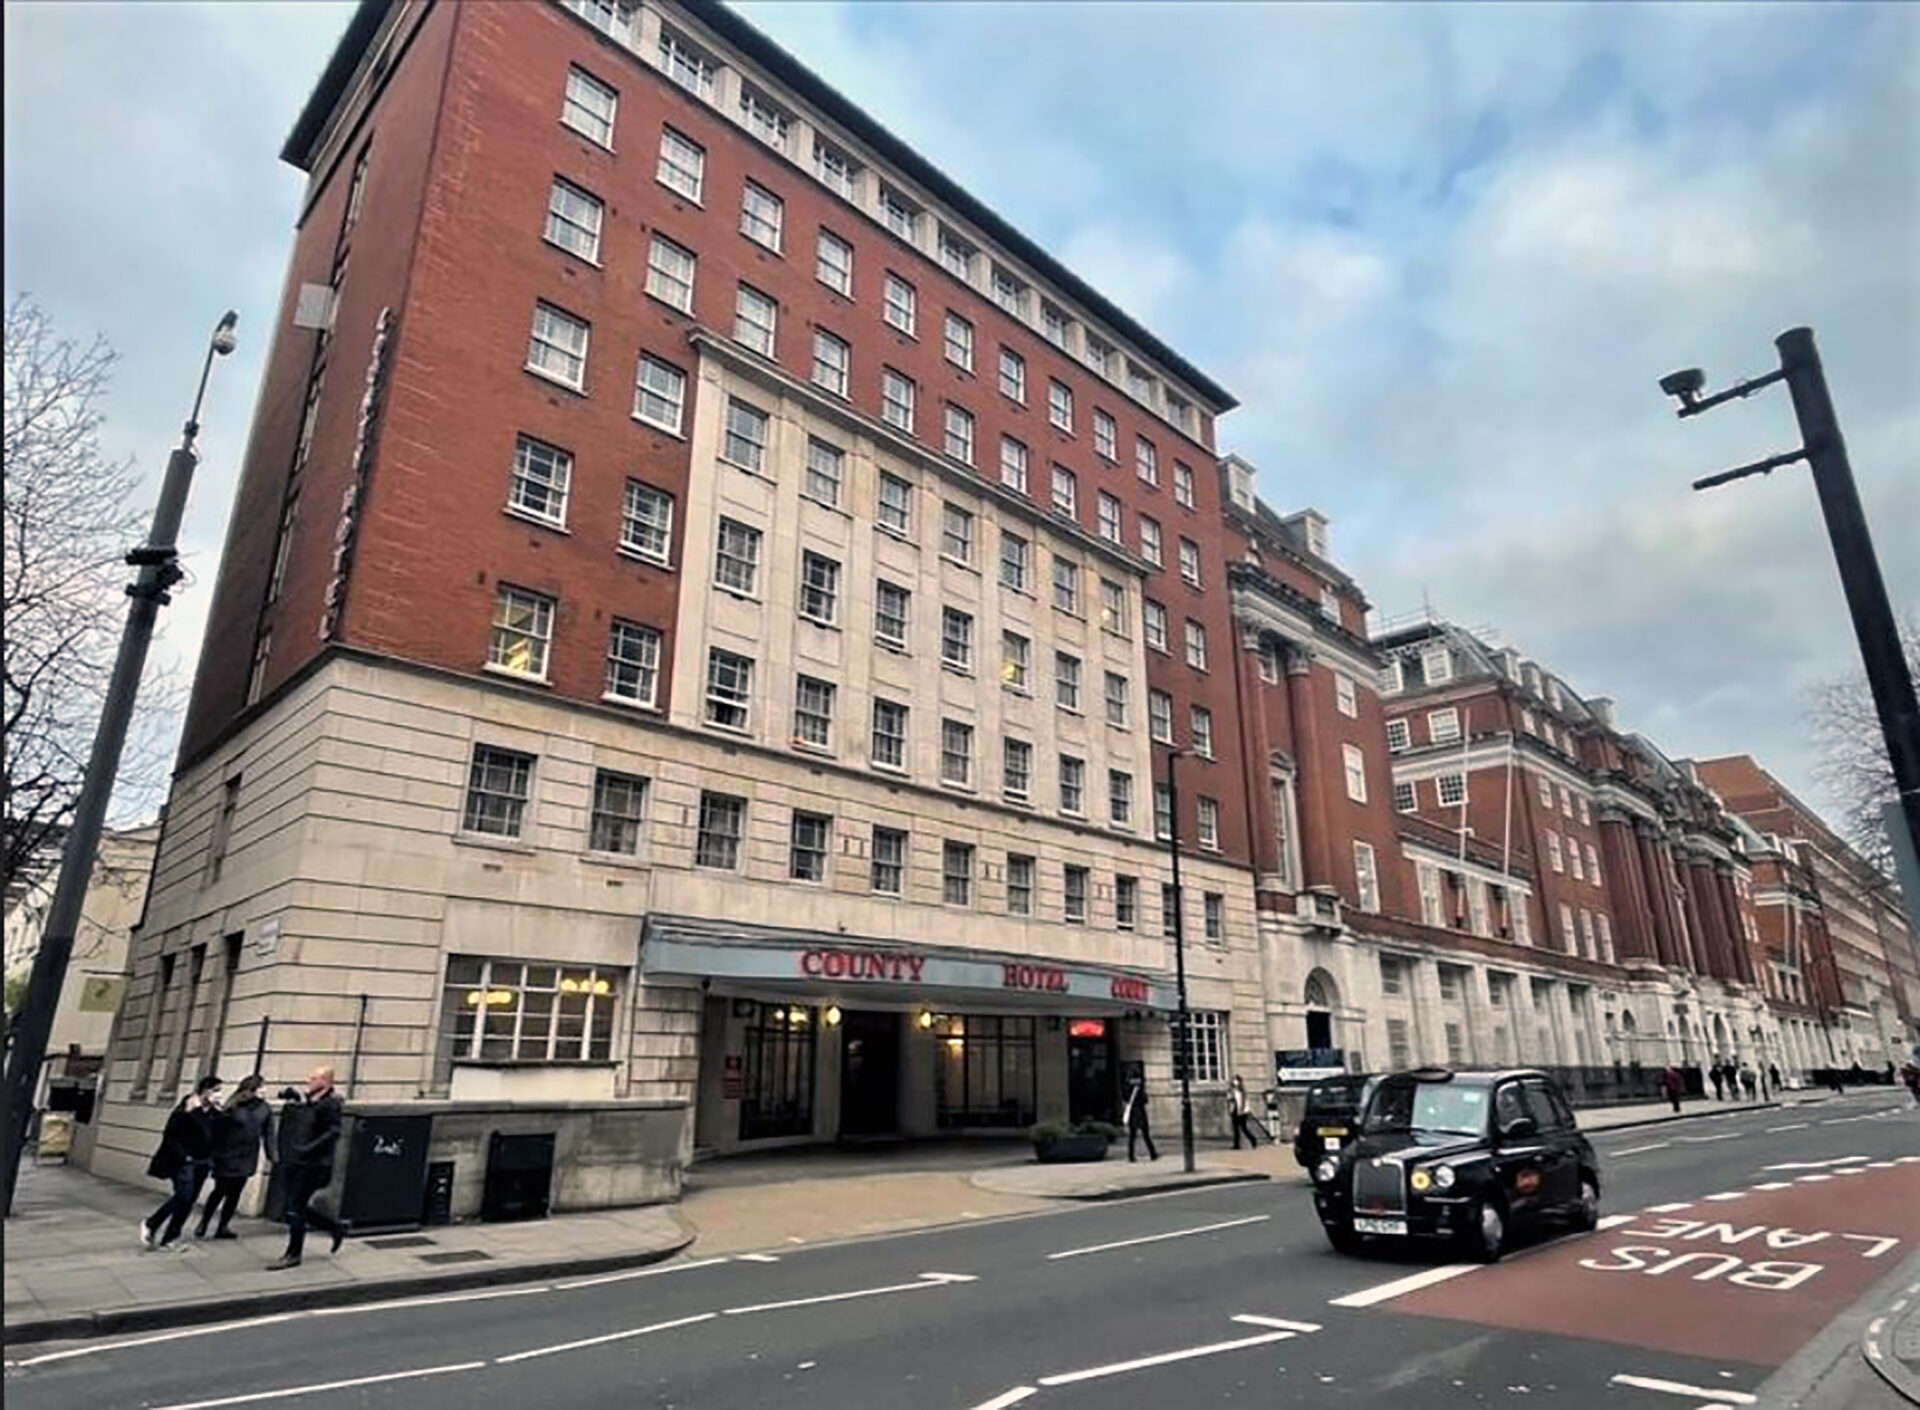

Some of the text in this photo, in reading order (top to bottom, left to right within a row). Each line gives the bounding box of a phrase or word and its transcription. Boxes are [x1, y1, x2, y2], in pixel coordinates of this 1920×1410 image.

[802, 951, 925, 981] COUNTY
[1621, 1218, 1900, 1257] LANE
[1579, 1246, 1824, 1290] BUS
